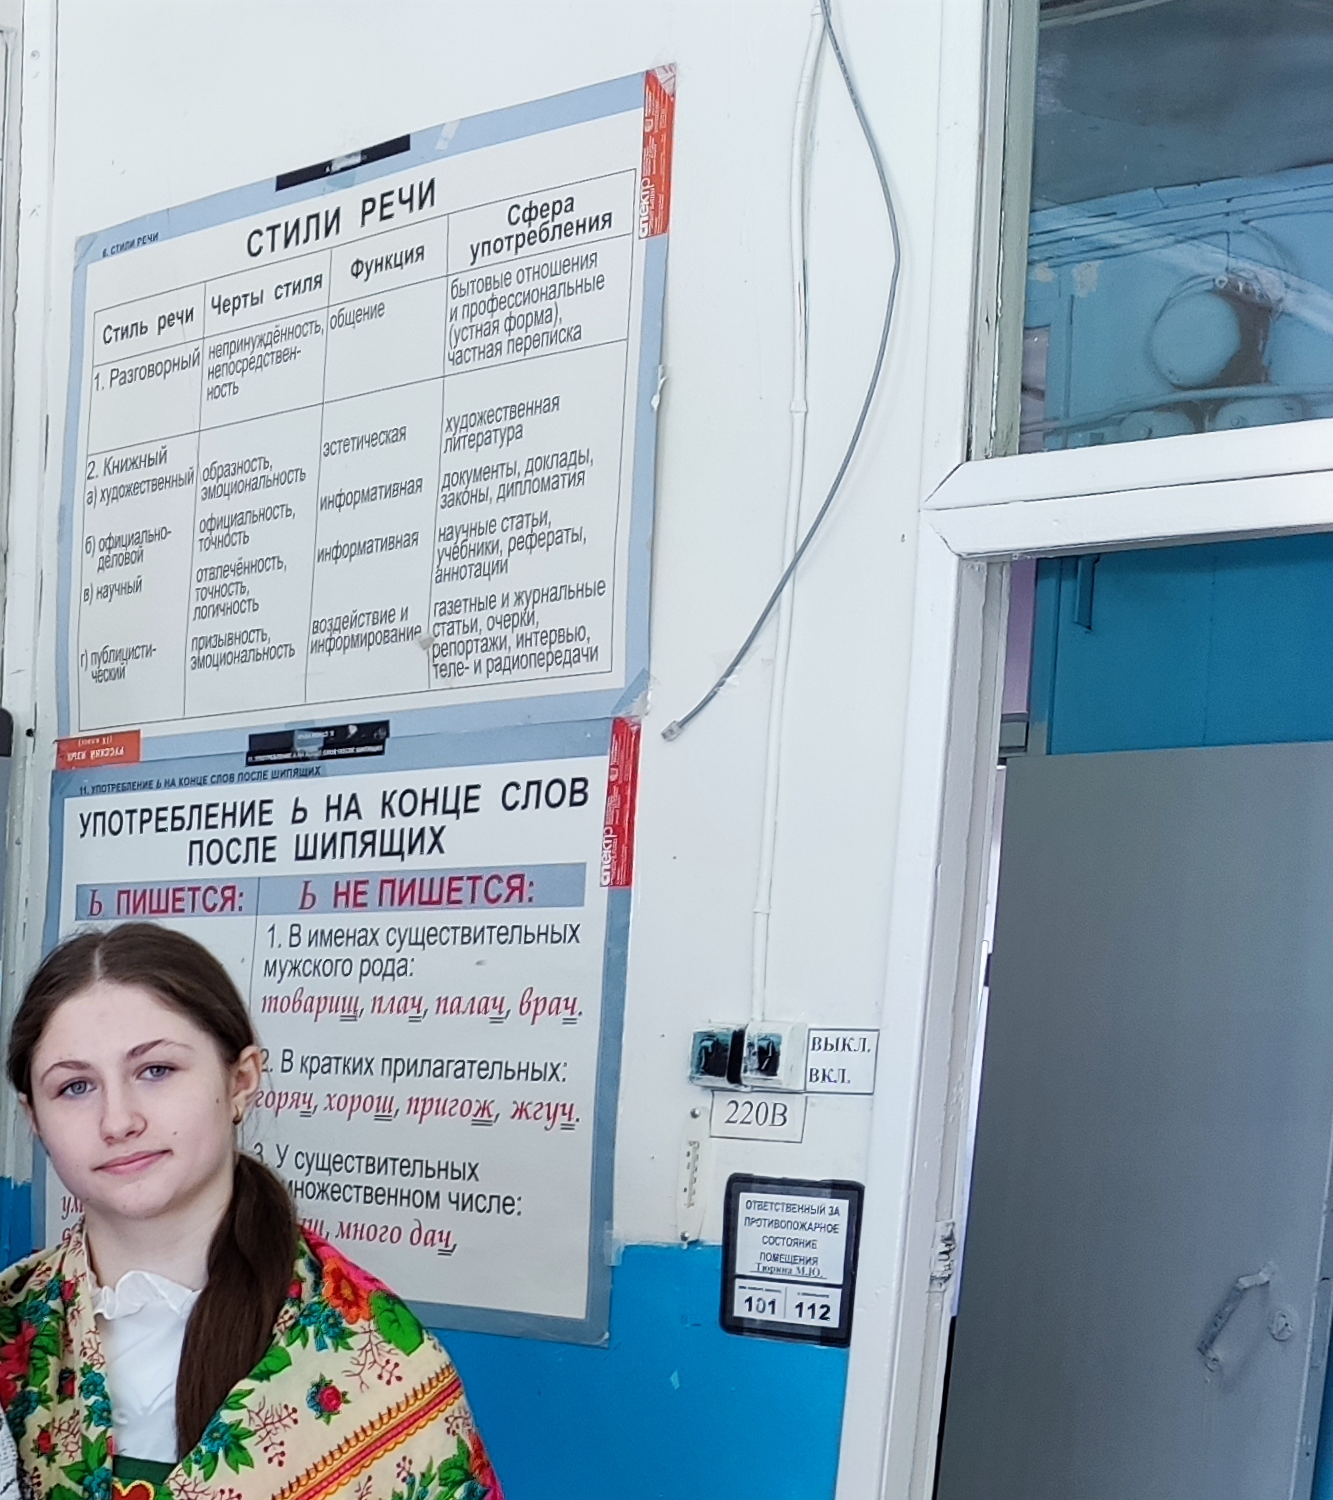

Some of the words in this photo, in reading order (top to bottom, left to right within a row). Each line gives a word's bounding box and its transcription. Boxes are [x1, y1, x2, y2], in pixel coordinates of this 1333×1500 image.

[247, 206, 341, 258] СТИЛИ
[359, 177, 436, 228] РЕЧИ
[507, 193, 575, 229] Сфера
[137, 232, 159, 246] РЕЧИ
[469, 210, 613, 265] употребления
[350, 244, 425, 280] Функция
[449, 271, 510, 300] бытовые
[514, 250, 598, 285] отношения
[211, 288, 265, 317] Черты
[274, 270, 324, 302] стиля
[449, 303, 458, 319] и
[461, 272, 606, 319] профессиональные
[102, 315, 148, 346] Стиль
[157, 303, 194, 336] речи
[329, 300, 386, 334] общение
[448, 320, 499, 350] (устная
[504, 305, 563, 338] форма),
[447, 338, 503, 367] частная
[506, 325, 582, 357] переписка
[94, 372, 104, 391] 1.
[109, 347, 201, 389] Разговорный
[445, 393, 560, 434] художественная
[323, 424, 407, 457] эстетическая
[443, 423, 523, 455] литература
[86, 461, 99, 481] 2.
[103, 446, 168, 480] Книжный
[91, 780, 153, 794] УПОТРЕБЛЕНИЕ
[164, 779, 176, 787] НА
[179, 775, 208, 787] КОНЦЕ
[211, 774, 234, 783] СЛОВ
[237, 771, 268, 782] ПОСЛЕ
[271, 766, 321, 779] ШИПЯЩИХ
[79, 798, 274, 839] УПОТРЕБЛЕНИЕ
[325, 797, 363, 823] НА
[382, 784, 481, 820] КОНЦЕ
[501, 776, 589, 812] СЛОВ
[188, 834, 276, 867] ПОСЛЕ
[295, 826, 447, 863] ШИПЯЩИХ
[116, 885, 243, 917] ПИШЕТСЯ:
[333, 880, 368, 910] НЕ
[378, 872, 534, 908] ПИШЕТСЯ:
[267, 923, 282, 949] 1.
[288, 922, 301, 948] В
[308, 924, 380, 949] именах
[386, 922, 580, 953] существительных
[264, 954, 354, 984] мужского
[359, 954, 415, 983] рода:
[261, 986, 363, 1021] товарищ,
[370, 991, 426, 1023] плач,
[435, 991, 512, 1024] палач,
[518, 986, 583, 1025] врач.
[811, 1037, 871, 1053] ВЫКЛ.
[281, 1049, 294, 1073] В
[300, 1055, 373, 1080] кратких
[381, 1055, 567, 1083] прилагательных:
[809, 1068, 850, 1084] ВКЛ.
[255, 1090, 318, 1118] горяч,
[324, 1094, 399, 1121] хорош,
[407, 1096, 499, 1126] пригож,
[511, 1099, 580, 1131] жгуч.
[276, 1144, 289, 1169] У
[294, 1148, 479, 1182] существительных
[448, 1192, 521, 1216] числе:
[746, 1200, 825, 1215] ОТВЕТСТВЕННЫЙ
[828, 1206, 840, 1216] ЗА
[336, 1219, 401, 1245] много
[410, 1219, 457, 1257] дач,
[744, 1217, 839, 1233] ПРОТИВОПОЖАРНОЕ
[762, 1235, 817, 1249] СОСТОЯНИЕ
[760, 1252, 818, 1265] ПОМЕЩЕНИЯ
[744, 1296, 776, 1315] 101
[795, 1302, 830, 1320] 112
